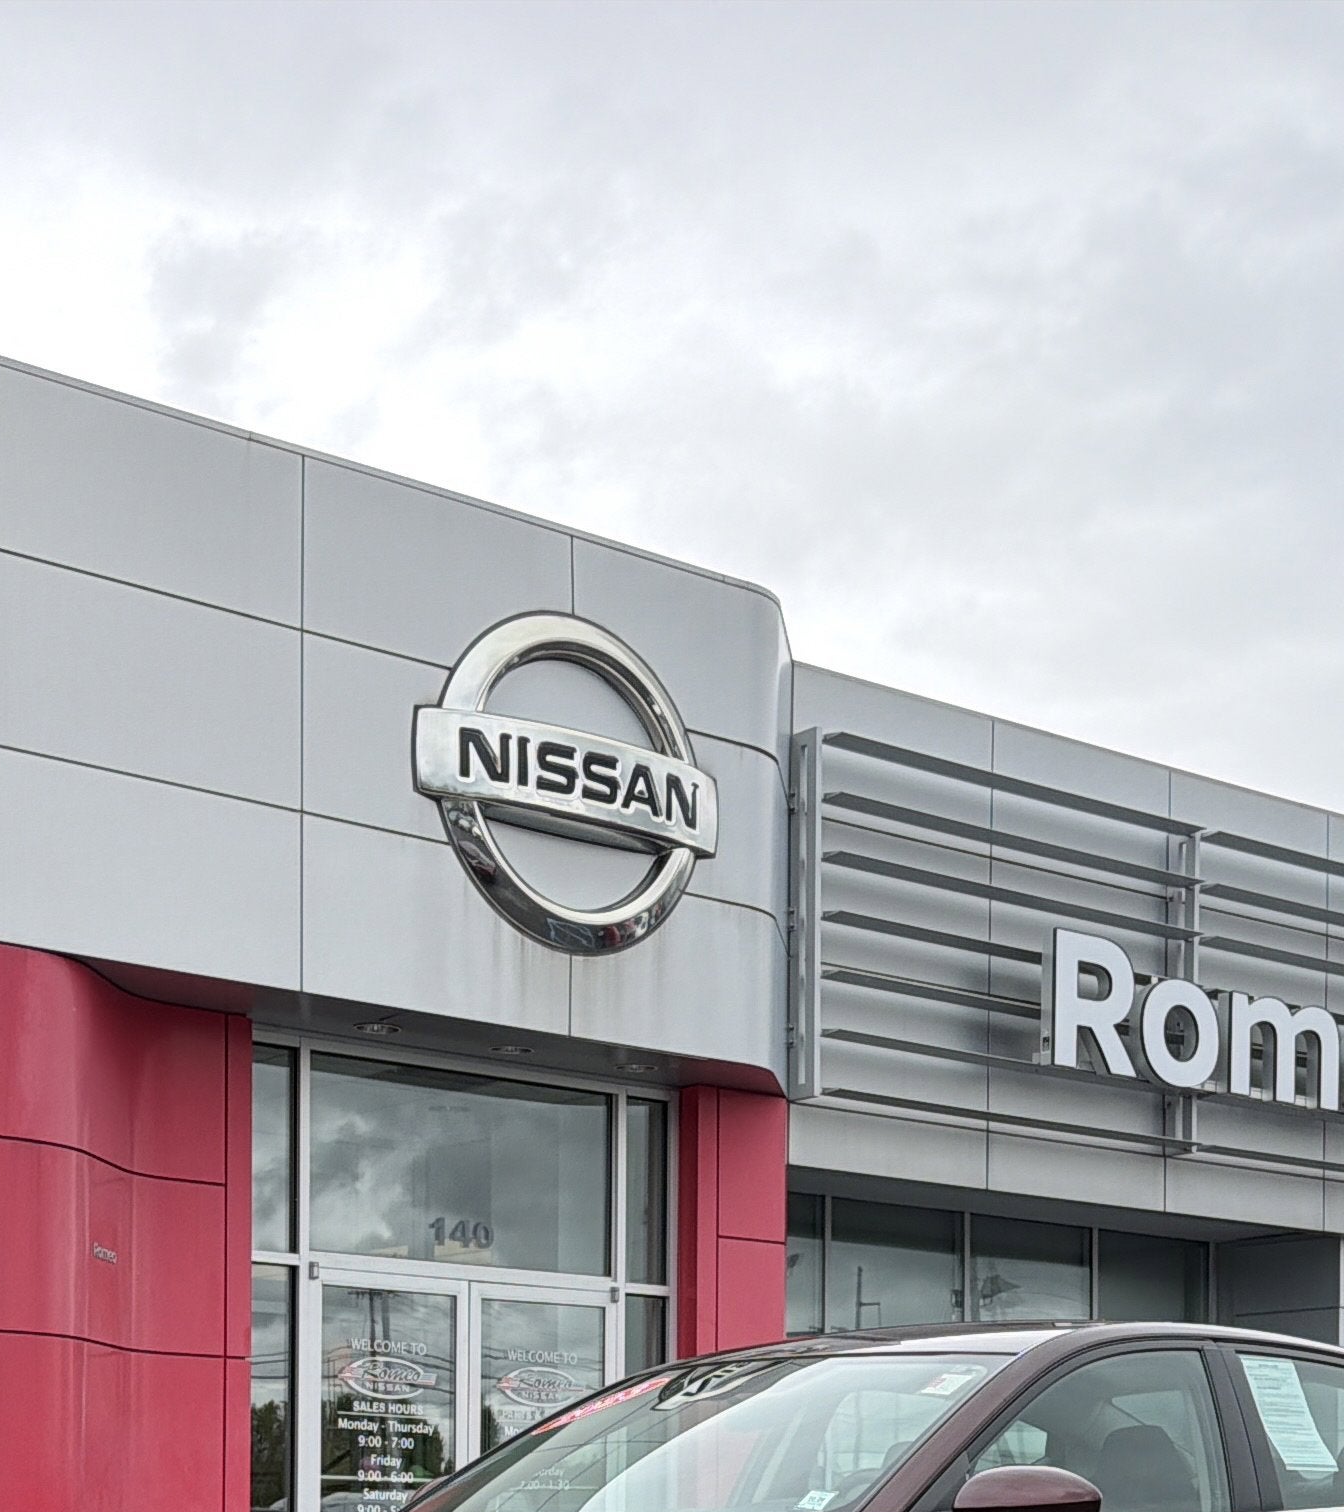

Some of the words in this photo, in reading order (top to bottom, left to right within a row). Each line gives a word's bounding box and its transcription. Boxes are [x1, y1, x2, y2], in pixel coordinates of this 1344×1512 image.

[458, 726, 700, 830] NISSAN
[428, 1216, 495, 1249] 140
[351, 1338, 408, 1354] WELCOME
[410, 1342, 427, 1356] TO
[507, 1349, 560, 1364] WELCOME
[563, 1352, 578, 1365] TO
[362, 1360, 422, 1383] Romeo
[365, 1381, 410, 1393] NISSAN
[352, 1400, 386, 1413] SALES
[388, 1403, 424, 1416] HOURS
[337, 1417, 380, 1432] Monday
[387, 1420, 435, 1436] Thursday
[357, 1434, 382, 1448] 9:00
[391, 1436, 415, 1449] 7:00
[370, 1453, 403, 1469] Friday
[357, 1469, 382, 1482] 9:00
[390, 1471, 414, 1483] 6:00
[363, 1487, 409, 1503] Saturday
